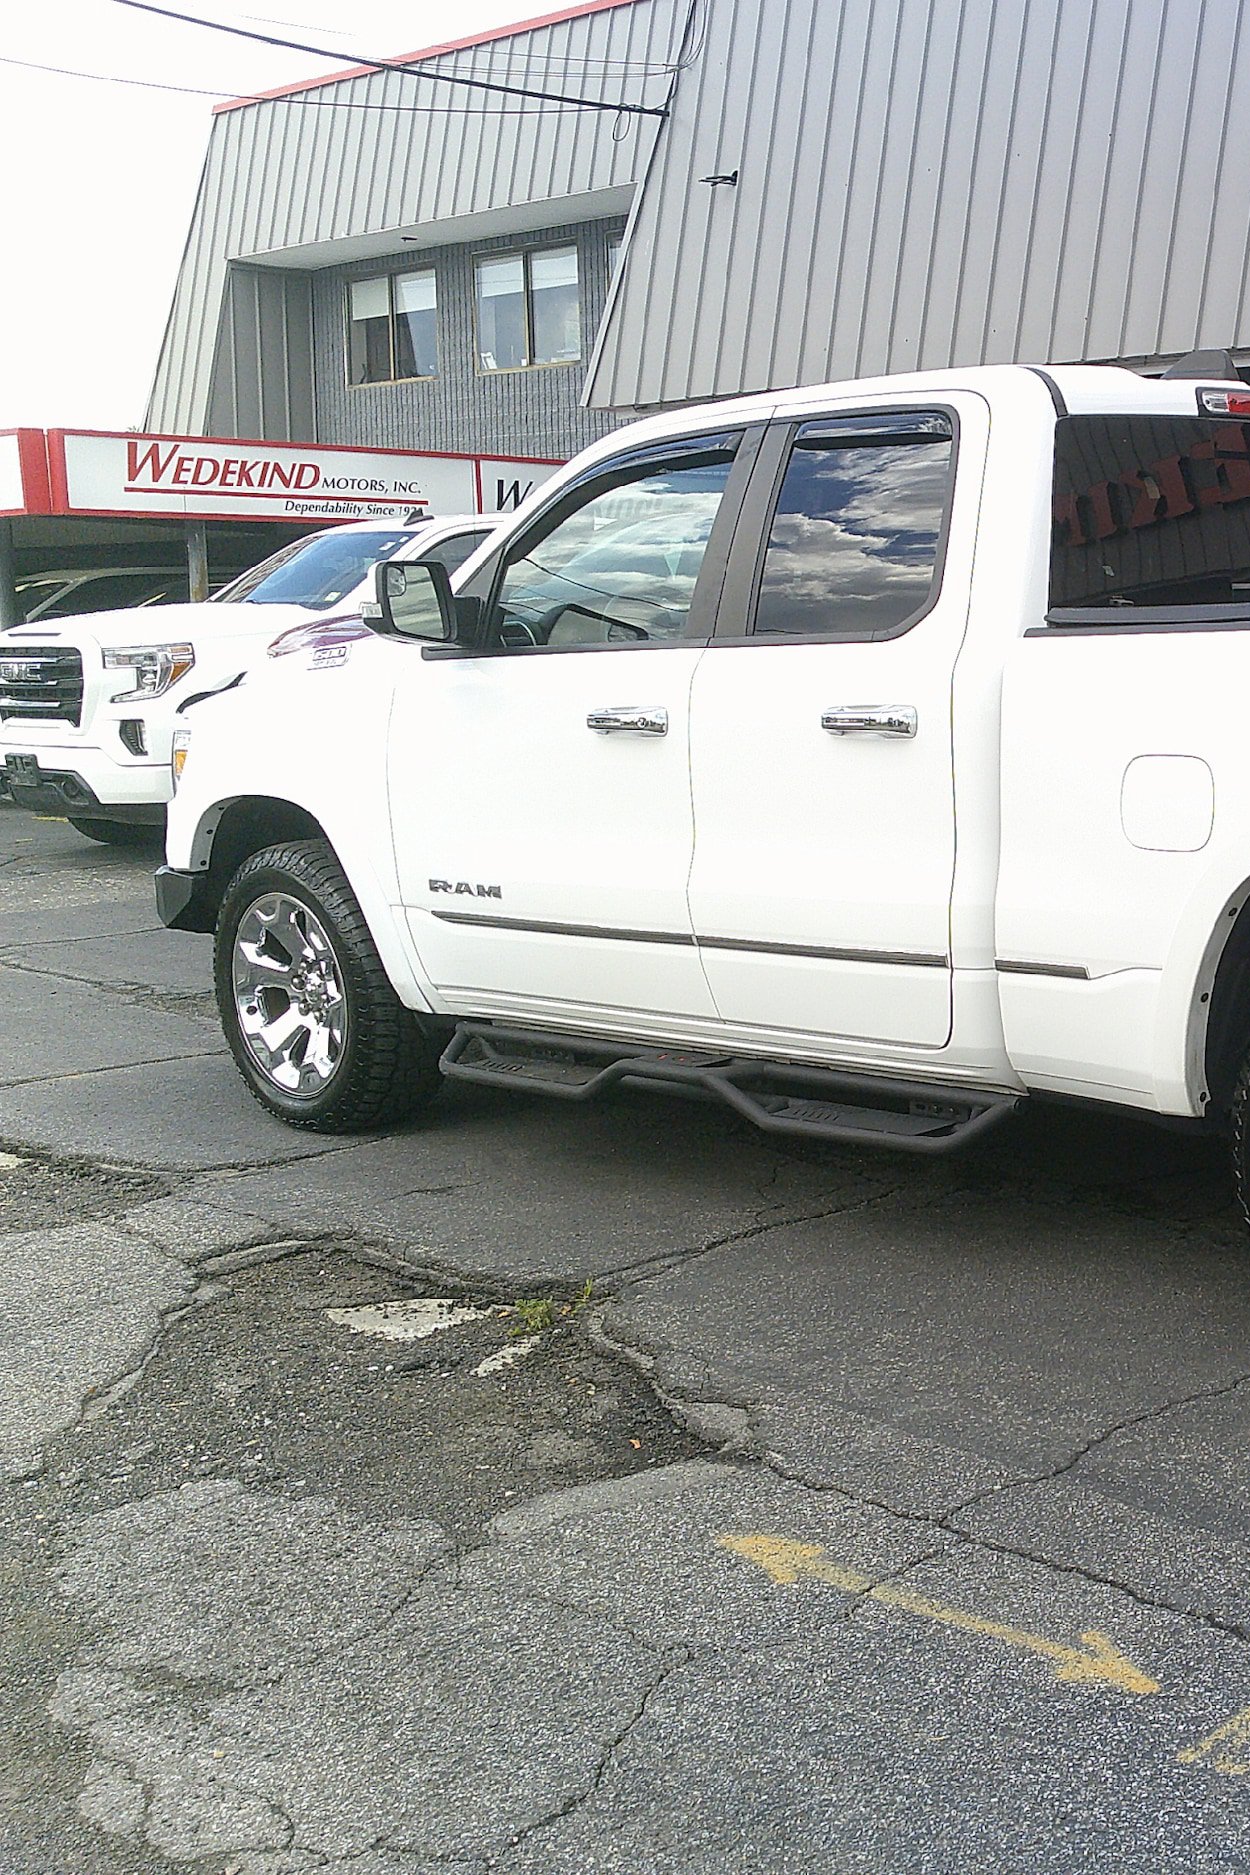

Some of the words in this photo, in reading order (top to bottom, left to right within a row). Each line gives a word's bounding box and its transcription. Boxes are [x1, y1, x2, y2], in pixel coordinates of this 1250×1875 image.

[126, 441, 320, 490] WEDEKIND
[321, 477, 389, 494] MOTORS,
[393, 480, 421, 494] INC.
[285, 500, 363, 517] Dependability
[366, 503, 396, 516] Since
[398, 506, 423, 517] 19
[1, 663, 42, 681] GMC
[428, 879, 502, 899] RAM
